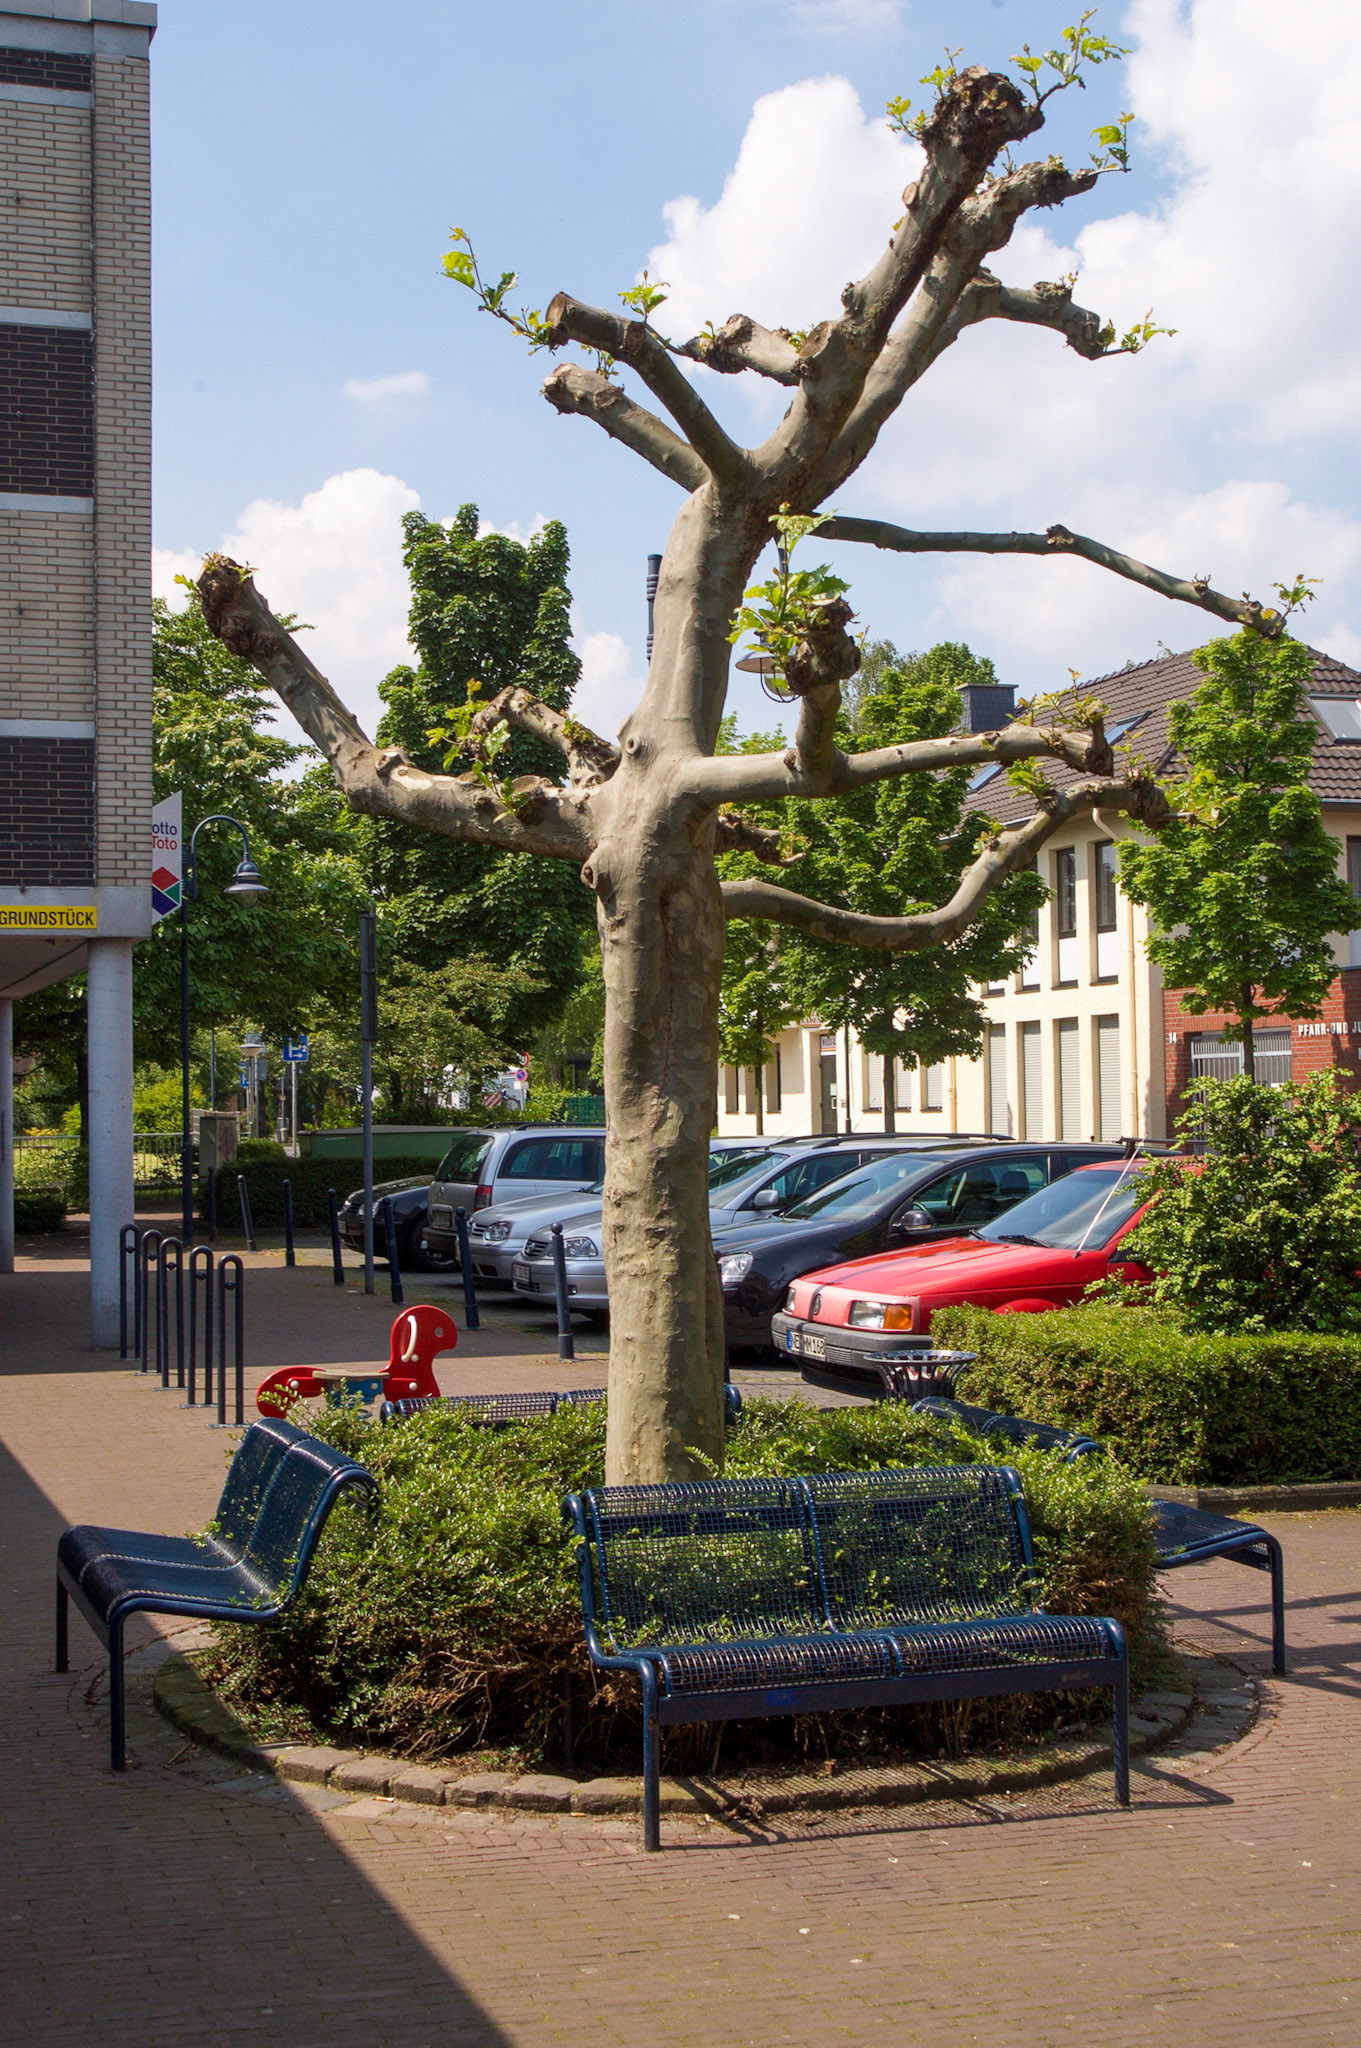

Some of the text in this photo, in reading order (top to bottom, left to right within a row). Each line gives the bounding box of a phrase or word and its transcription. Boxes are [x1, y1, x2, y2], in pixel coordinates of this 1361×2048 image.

[152, 822, 177, 835] otto
[152, 835, 178, 850] Toto
[0, 908, 94, 926] GRUNDSTÜCK
